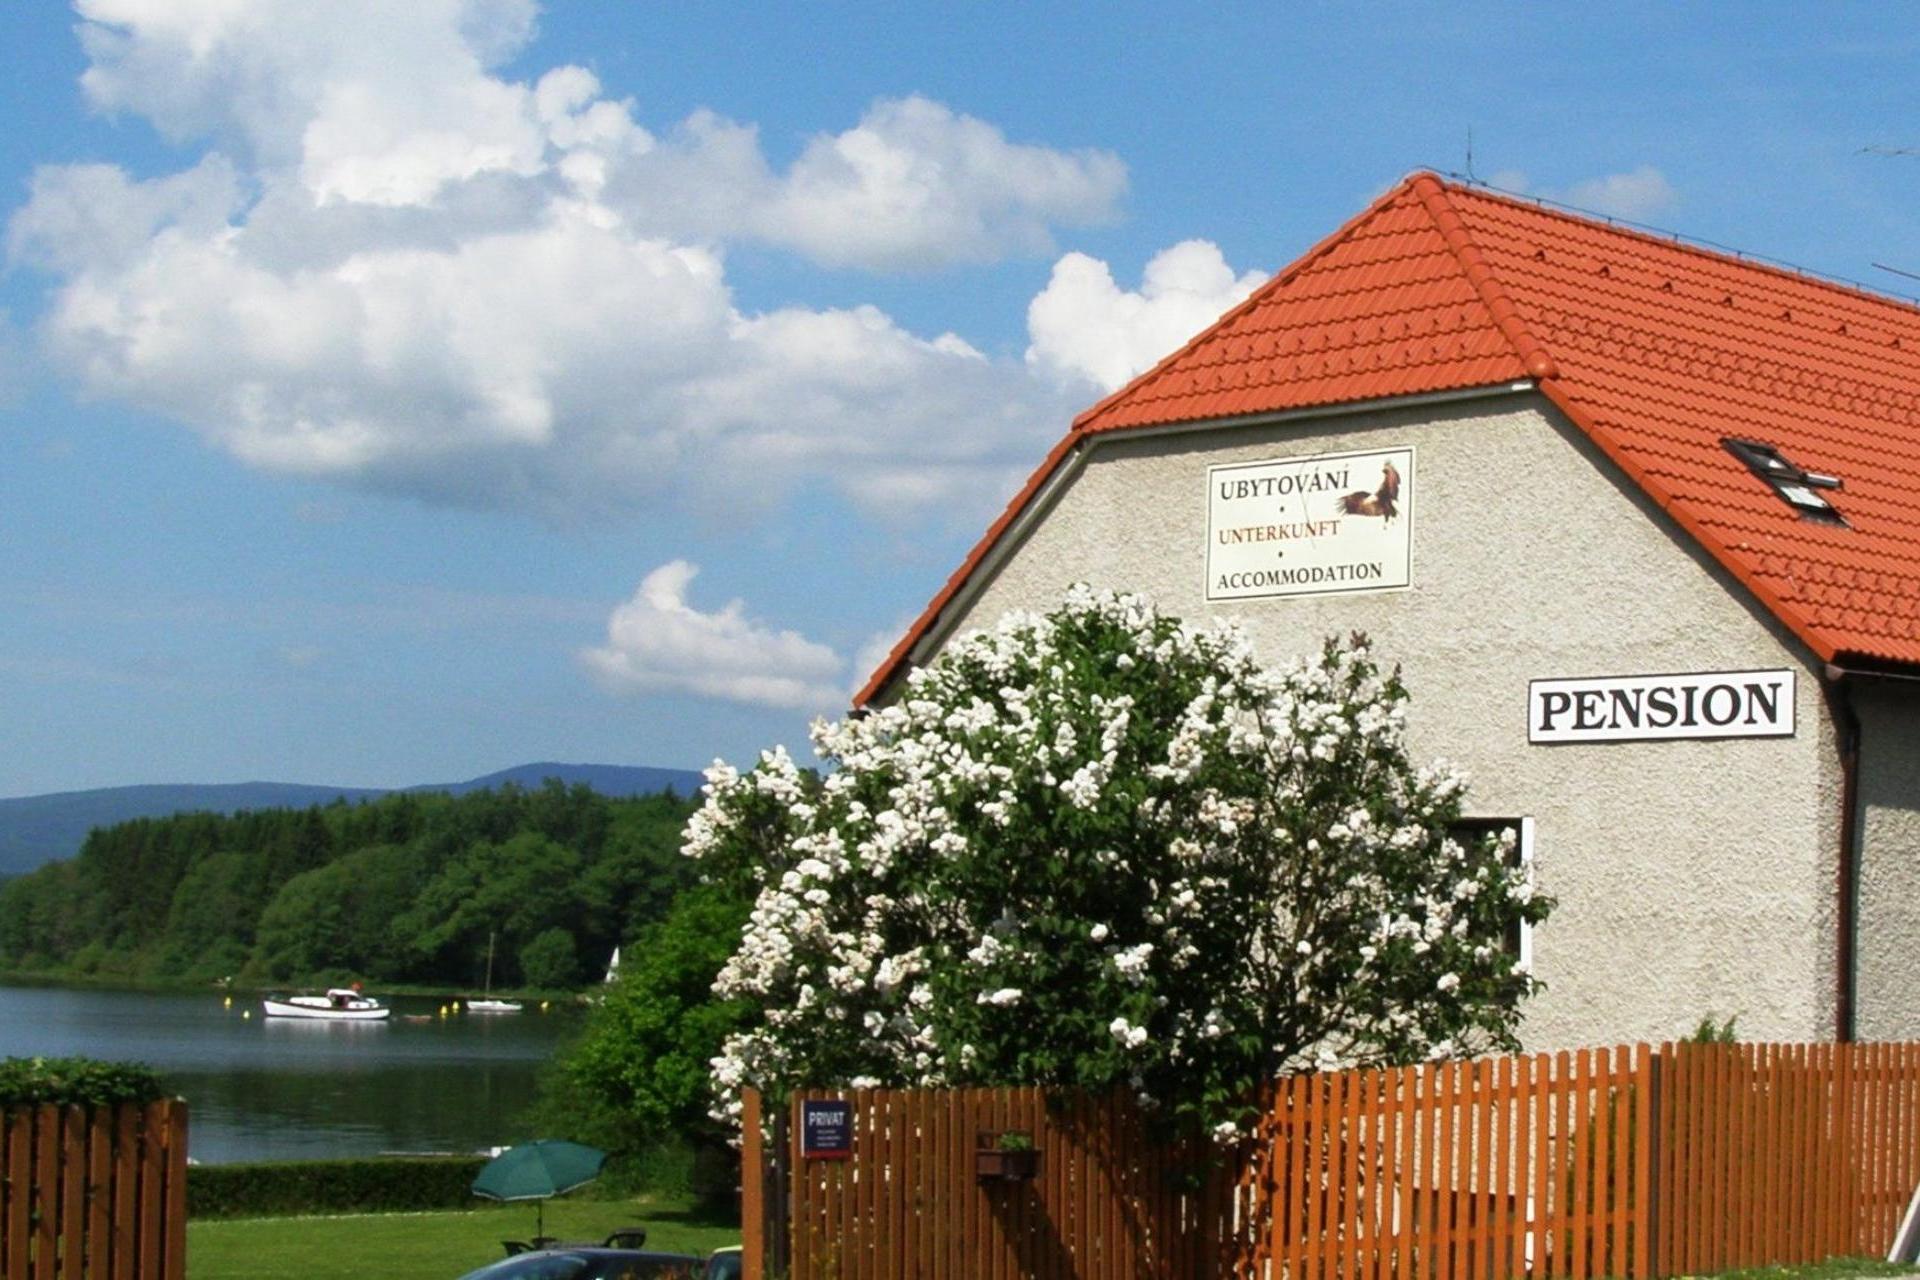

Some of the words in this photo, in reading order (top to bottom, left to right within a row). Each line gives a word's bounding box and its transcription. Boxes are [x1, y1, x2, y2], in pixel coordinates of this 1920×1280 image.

[1220, 464, 1350, 500] UBYTOVÁNÍ
[1219, 520, 1341, 544] UNTERKUNFT
[1217, 562, 1383, 589] ACCOMMODATION
[1539, 683, 1782, 731] PENSION
[808, 1111, 844, 1126] PRIVAT
